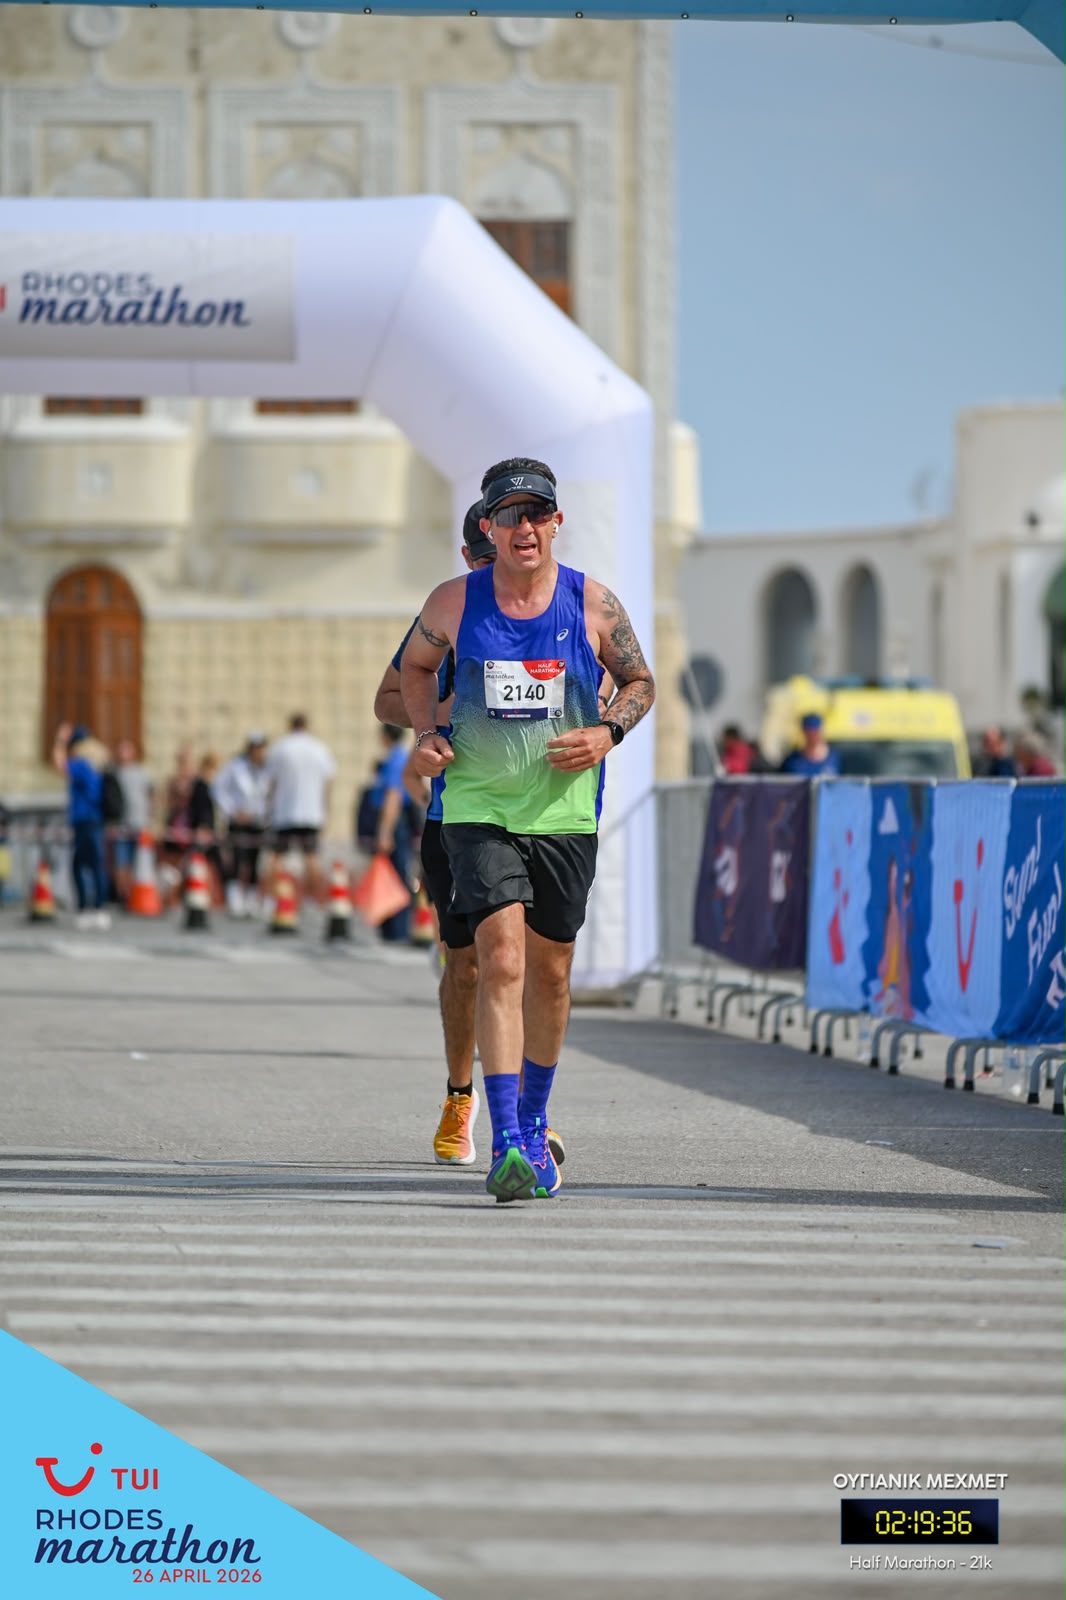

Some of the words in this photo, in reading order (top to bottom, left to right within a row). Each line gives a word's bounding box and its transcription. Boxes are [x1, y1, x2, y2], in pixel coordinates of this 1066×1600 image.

[21, 271, 154, 296] RHODES
[18, 285, 251, 328] marathon
[504, 684, 545, 701] 2140
